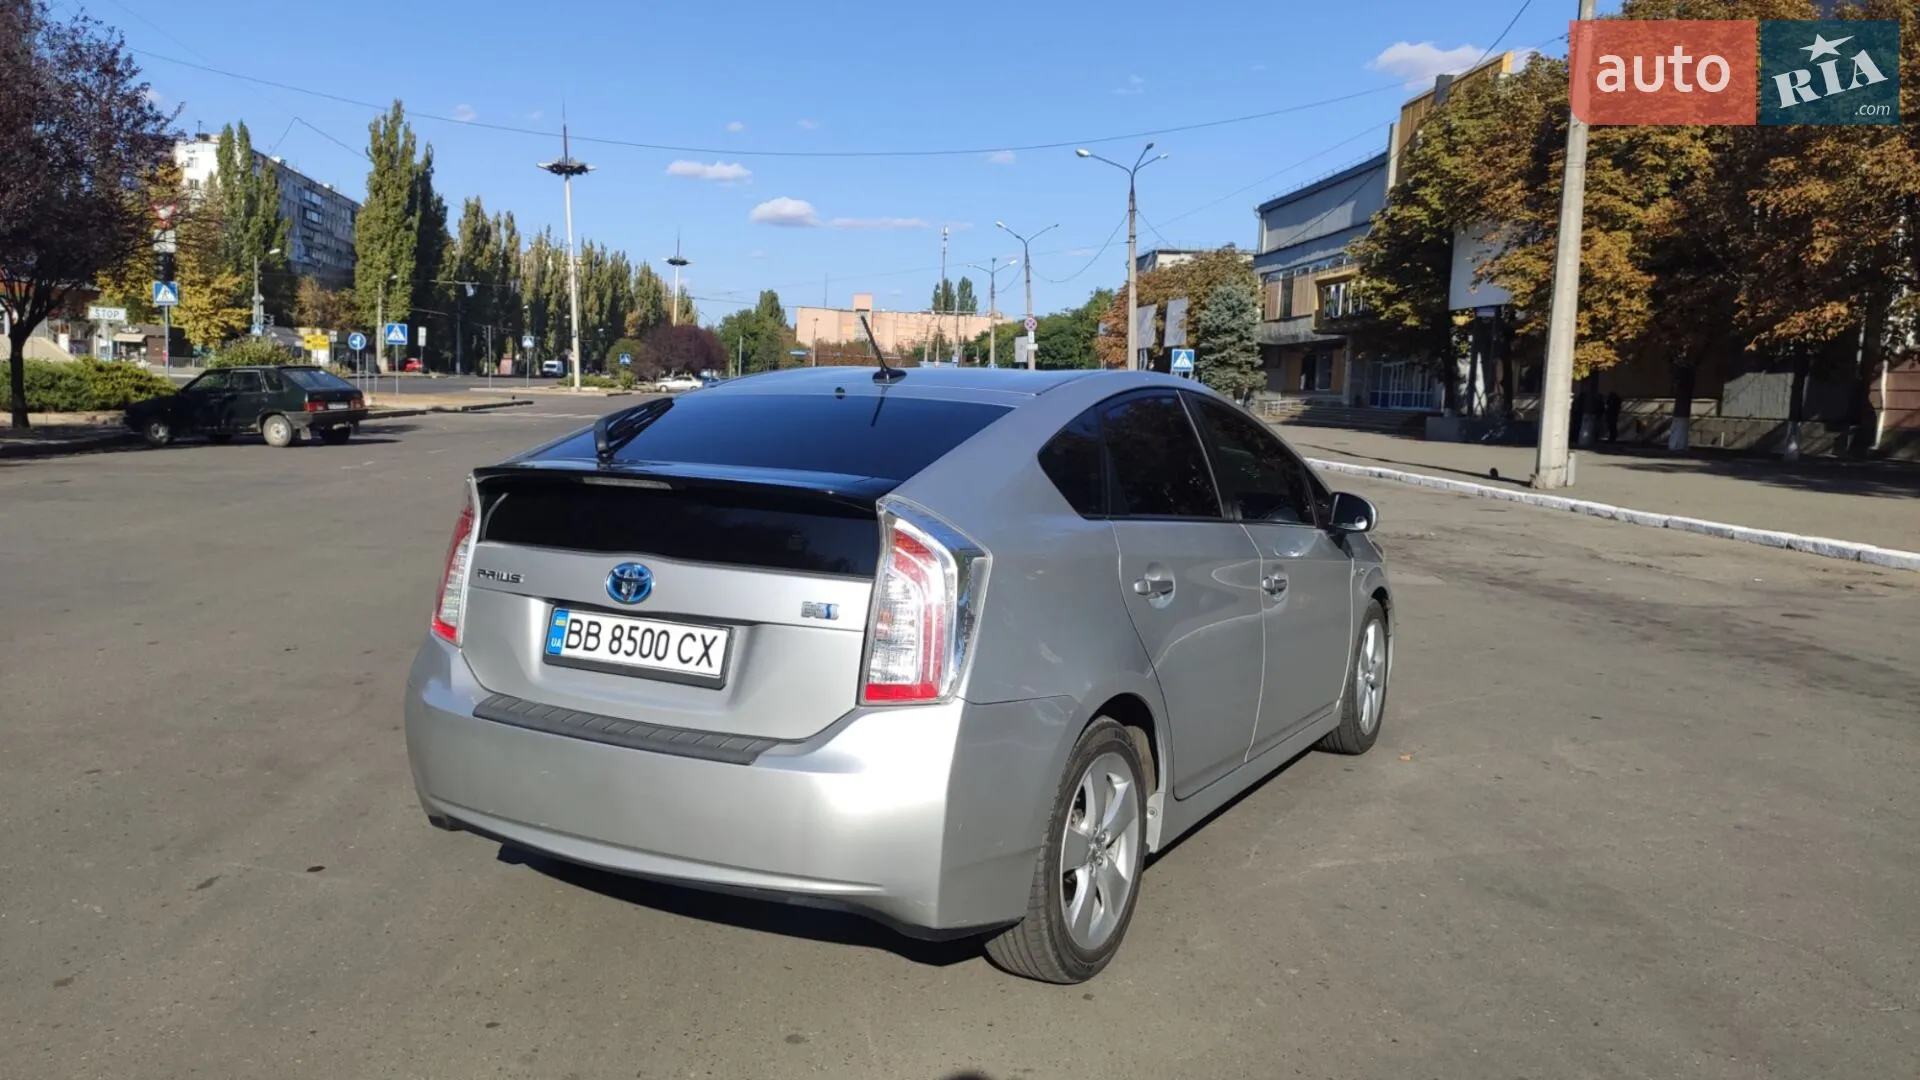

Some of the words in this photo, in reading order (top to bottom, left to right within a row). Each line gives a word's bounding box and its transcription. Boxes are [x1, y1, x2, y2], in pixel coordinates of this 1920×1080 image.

[95, 308, 119, 318] STOP
[477, 568, 521, 583] PRIUS
[551, 638, 562, 648] UA
[565, 619, 601, 651] BB
[608, 624, 670, 661] 8500
[677, 633, 718, 668] CX
